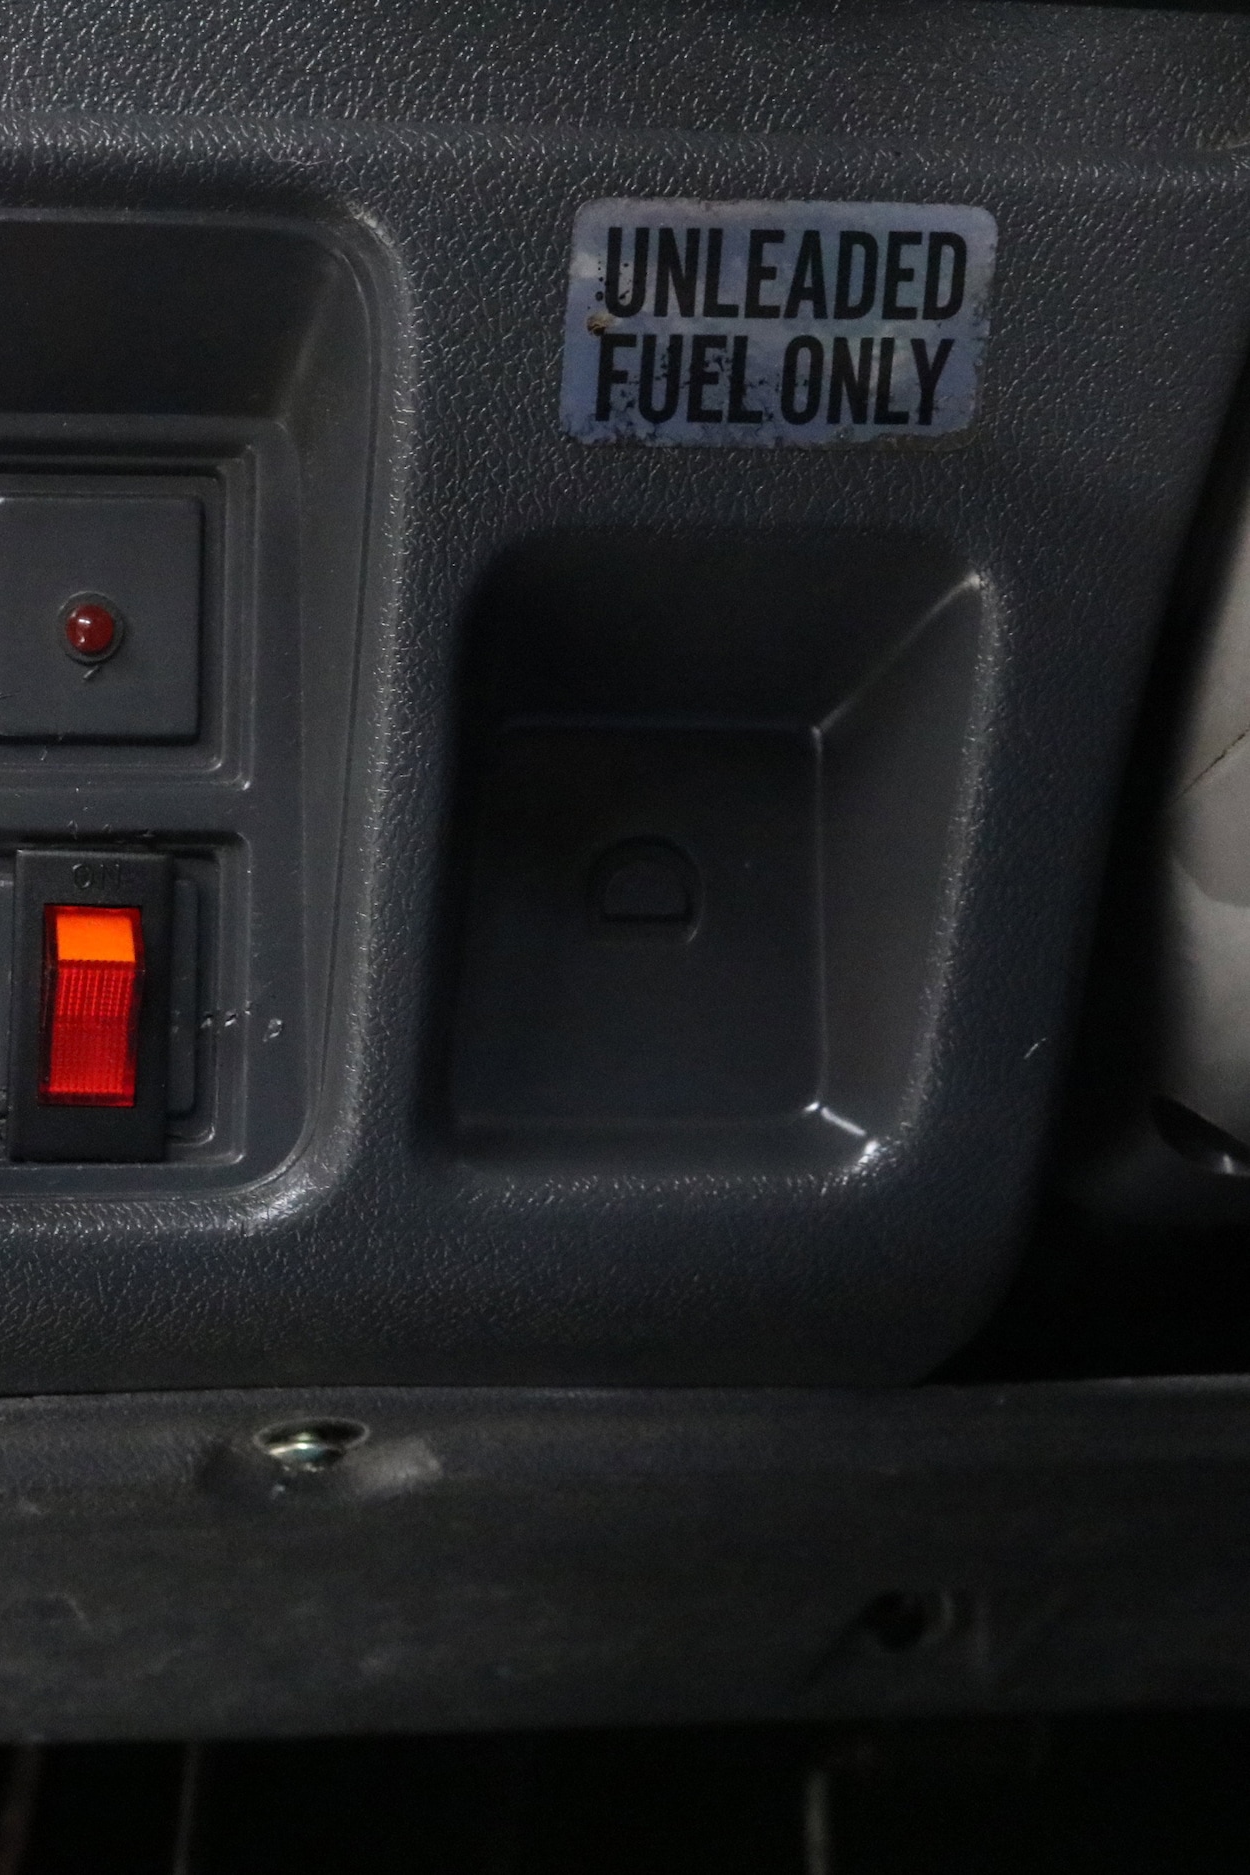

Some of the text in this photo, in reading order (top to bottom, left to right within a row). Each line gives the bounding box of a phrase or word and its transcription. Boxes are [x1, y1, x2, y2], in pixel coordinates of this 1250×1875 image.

[604, 227, 967, 320] UNLEADED
[595, 333, 955, 426] FUEL ONLY
[72, 863, 121, 890] ON
